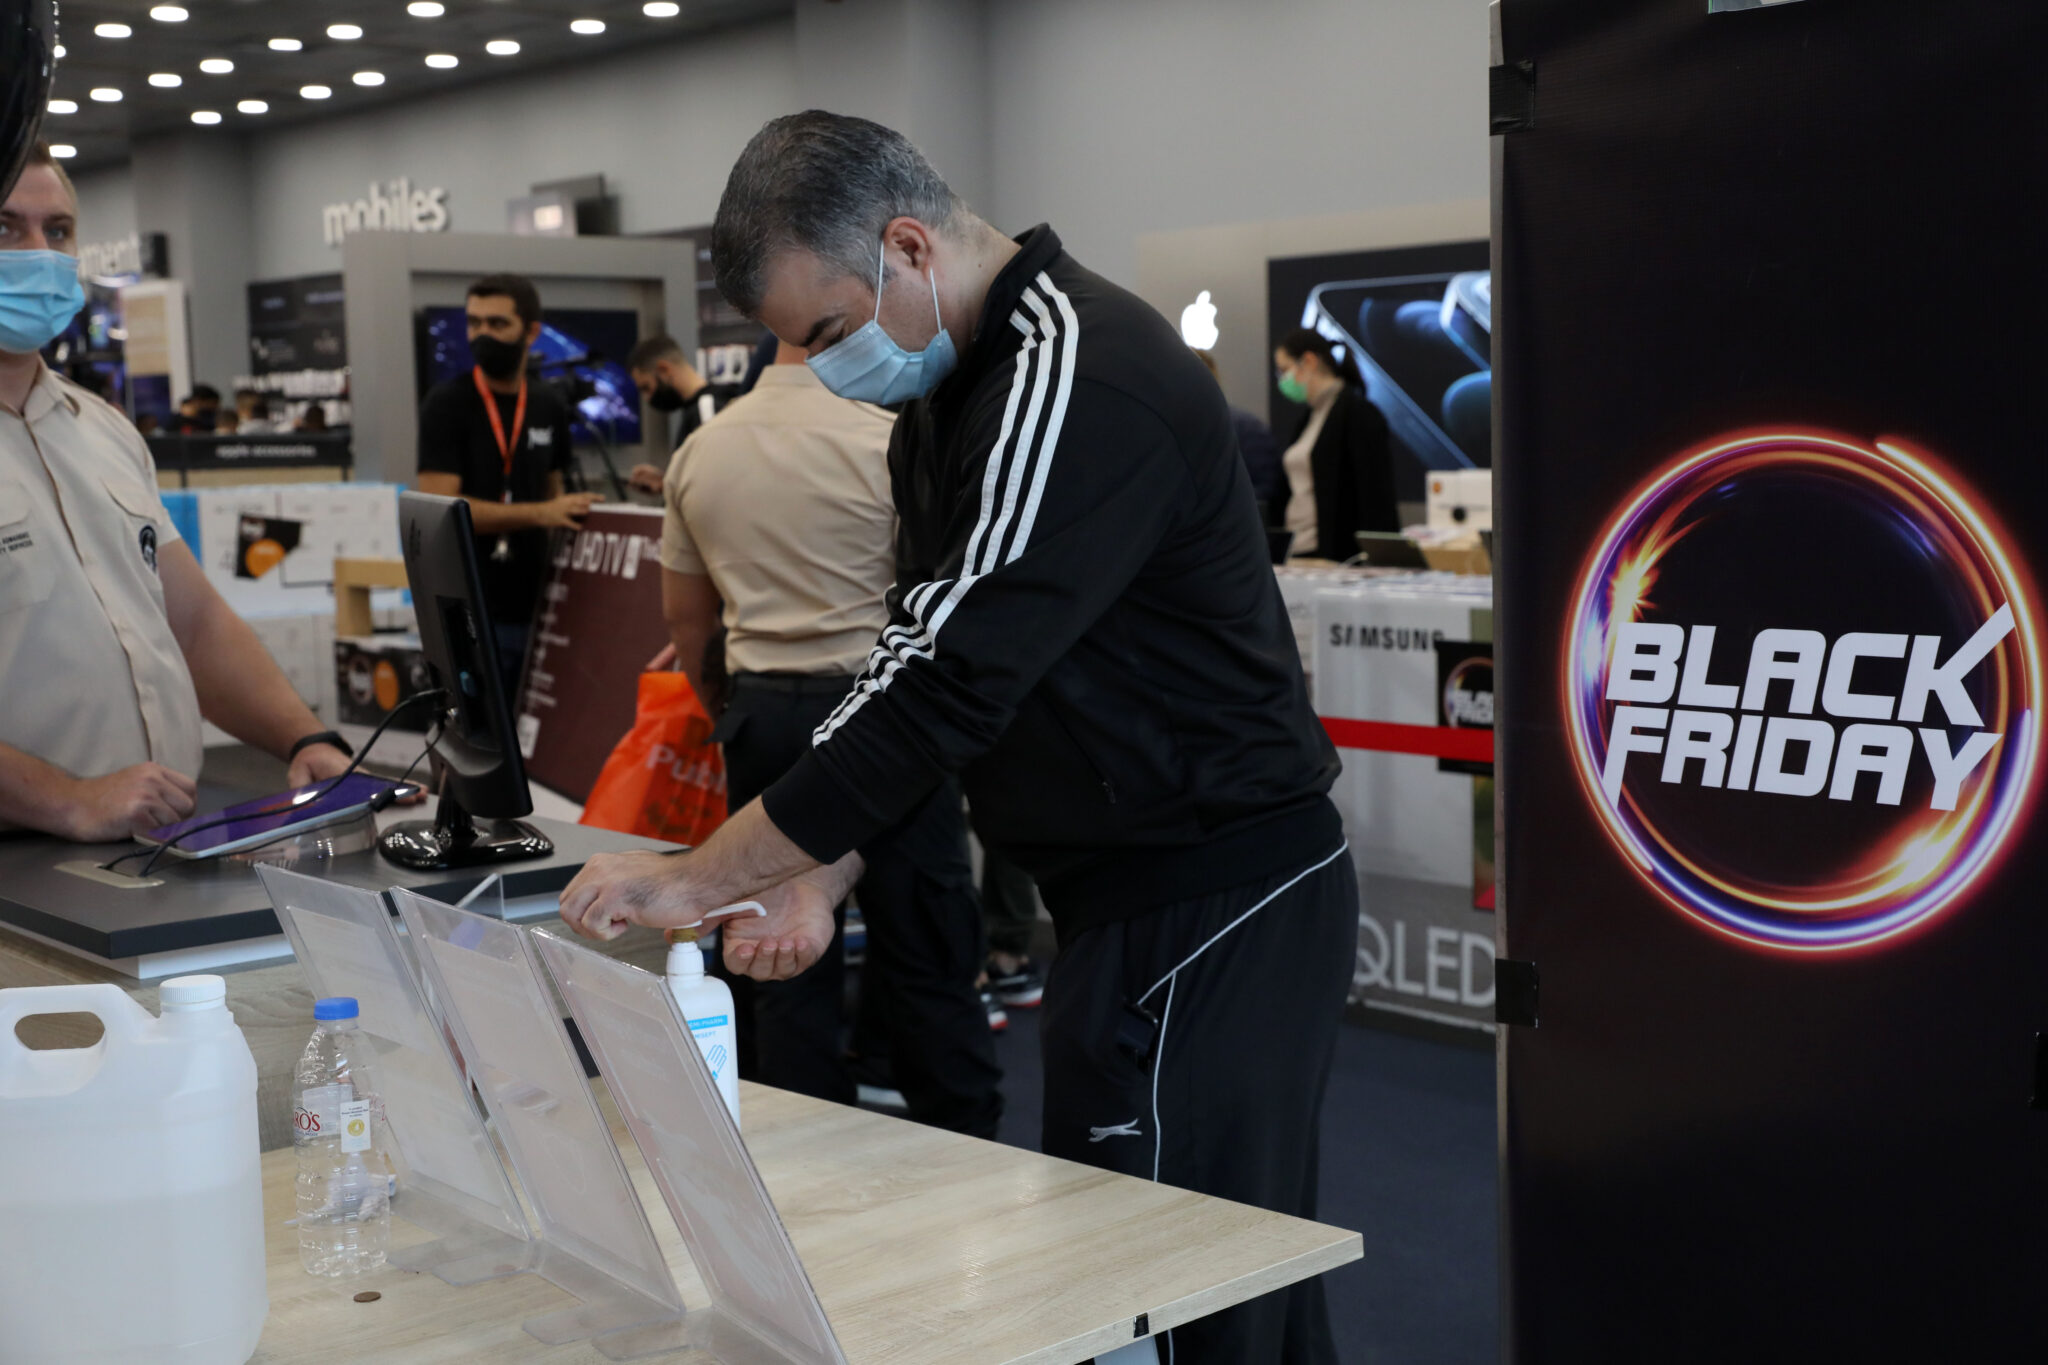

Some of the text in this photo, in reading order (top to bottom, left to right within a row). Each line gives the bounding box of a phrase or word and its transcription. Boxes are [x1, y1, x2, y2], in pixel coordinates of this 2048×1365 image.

[322, 176, 448, 245] mobiles
[1605, 601, 2015, 727] BLACK
[1602, 705, 2003, 812] FRIDAY
